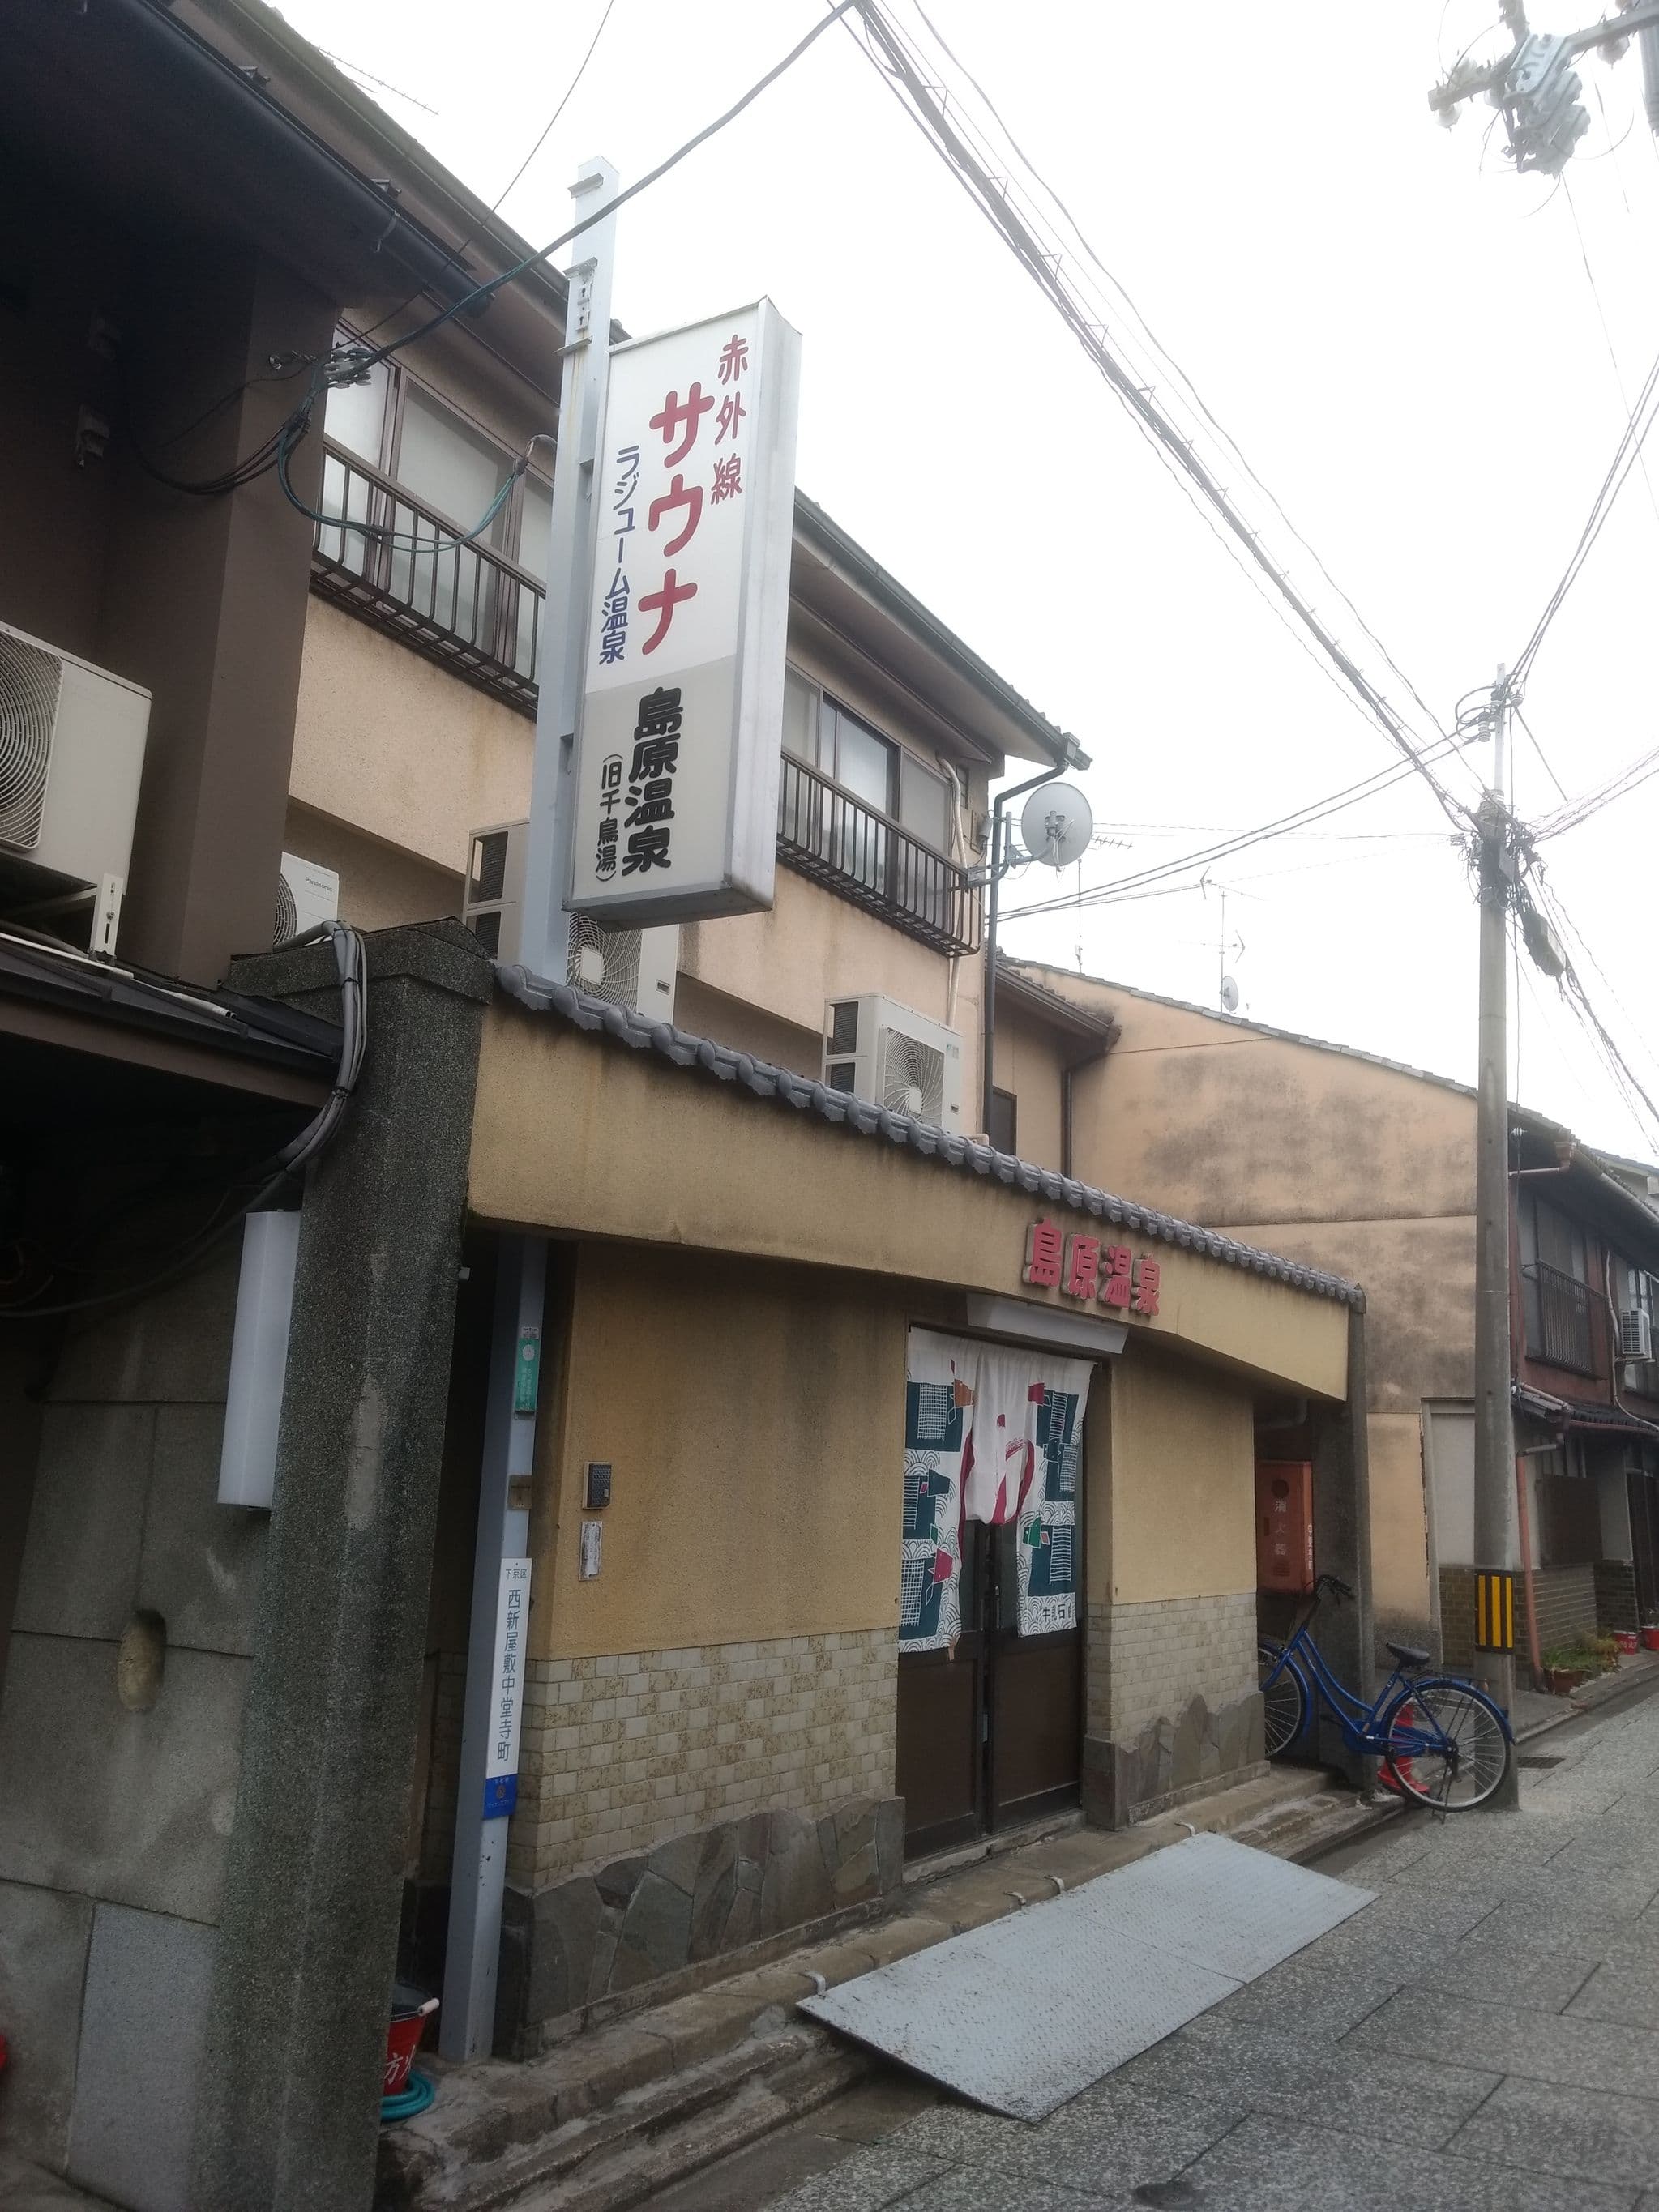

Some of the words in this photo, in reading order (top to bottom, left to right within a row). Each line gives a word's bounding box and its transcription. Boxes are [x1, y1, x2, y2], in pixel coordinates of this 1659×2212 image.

[710, 333, 749, 506] 赤外線
[598, 445, 640, 665] ラジューム温泉
[637, 381, 715, 655] サウナ
[621, 686, 683, 877] 島原温泉
[305, 876, 333, 893] Panasonic
[1023, 1218, 1161, 1317] 島原温泉
[505, 1568, 528, 1580] 下京区
[1274, 1499, 1287, 1556] 消火器
[497, 1589, 521, 1762] 西新屋敷中堂寺町
